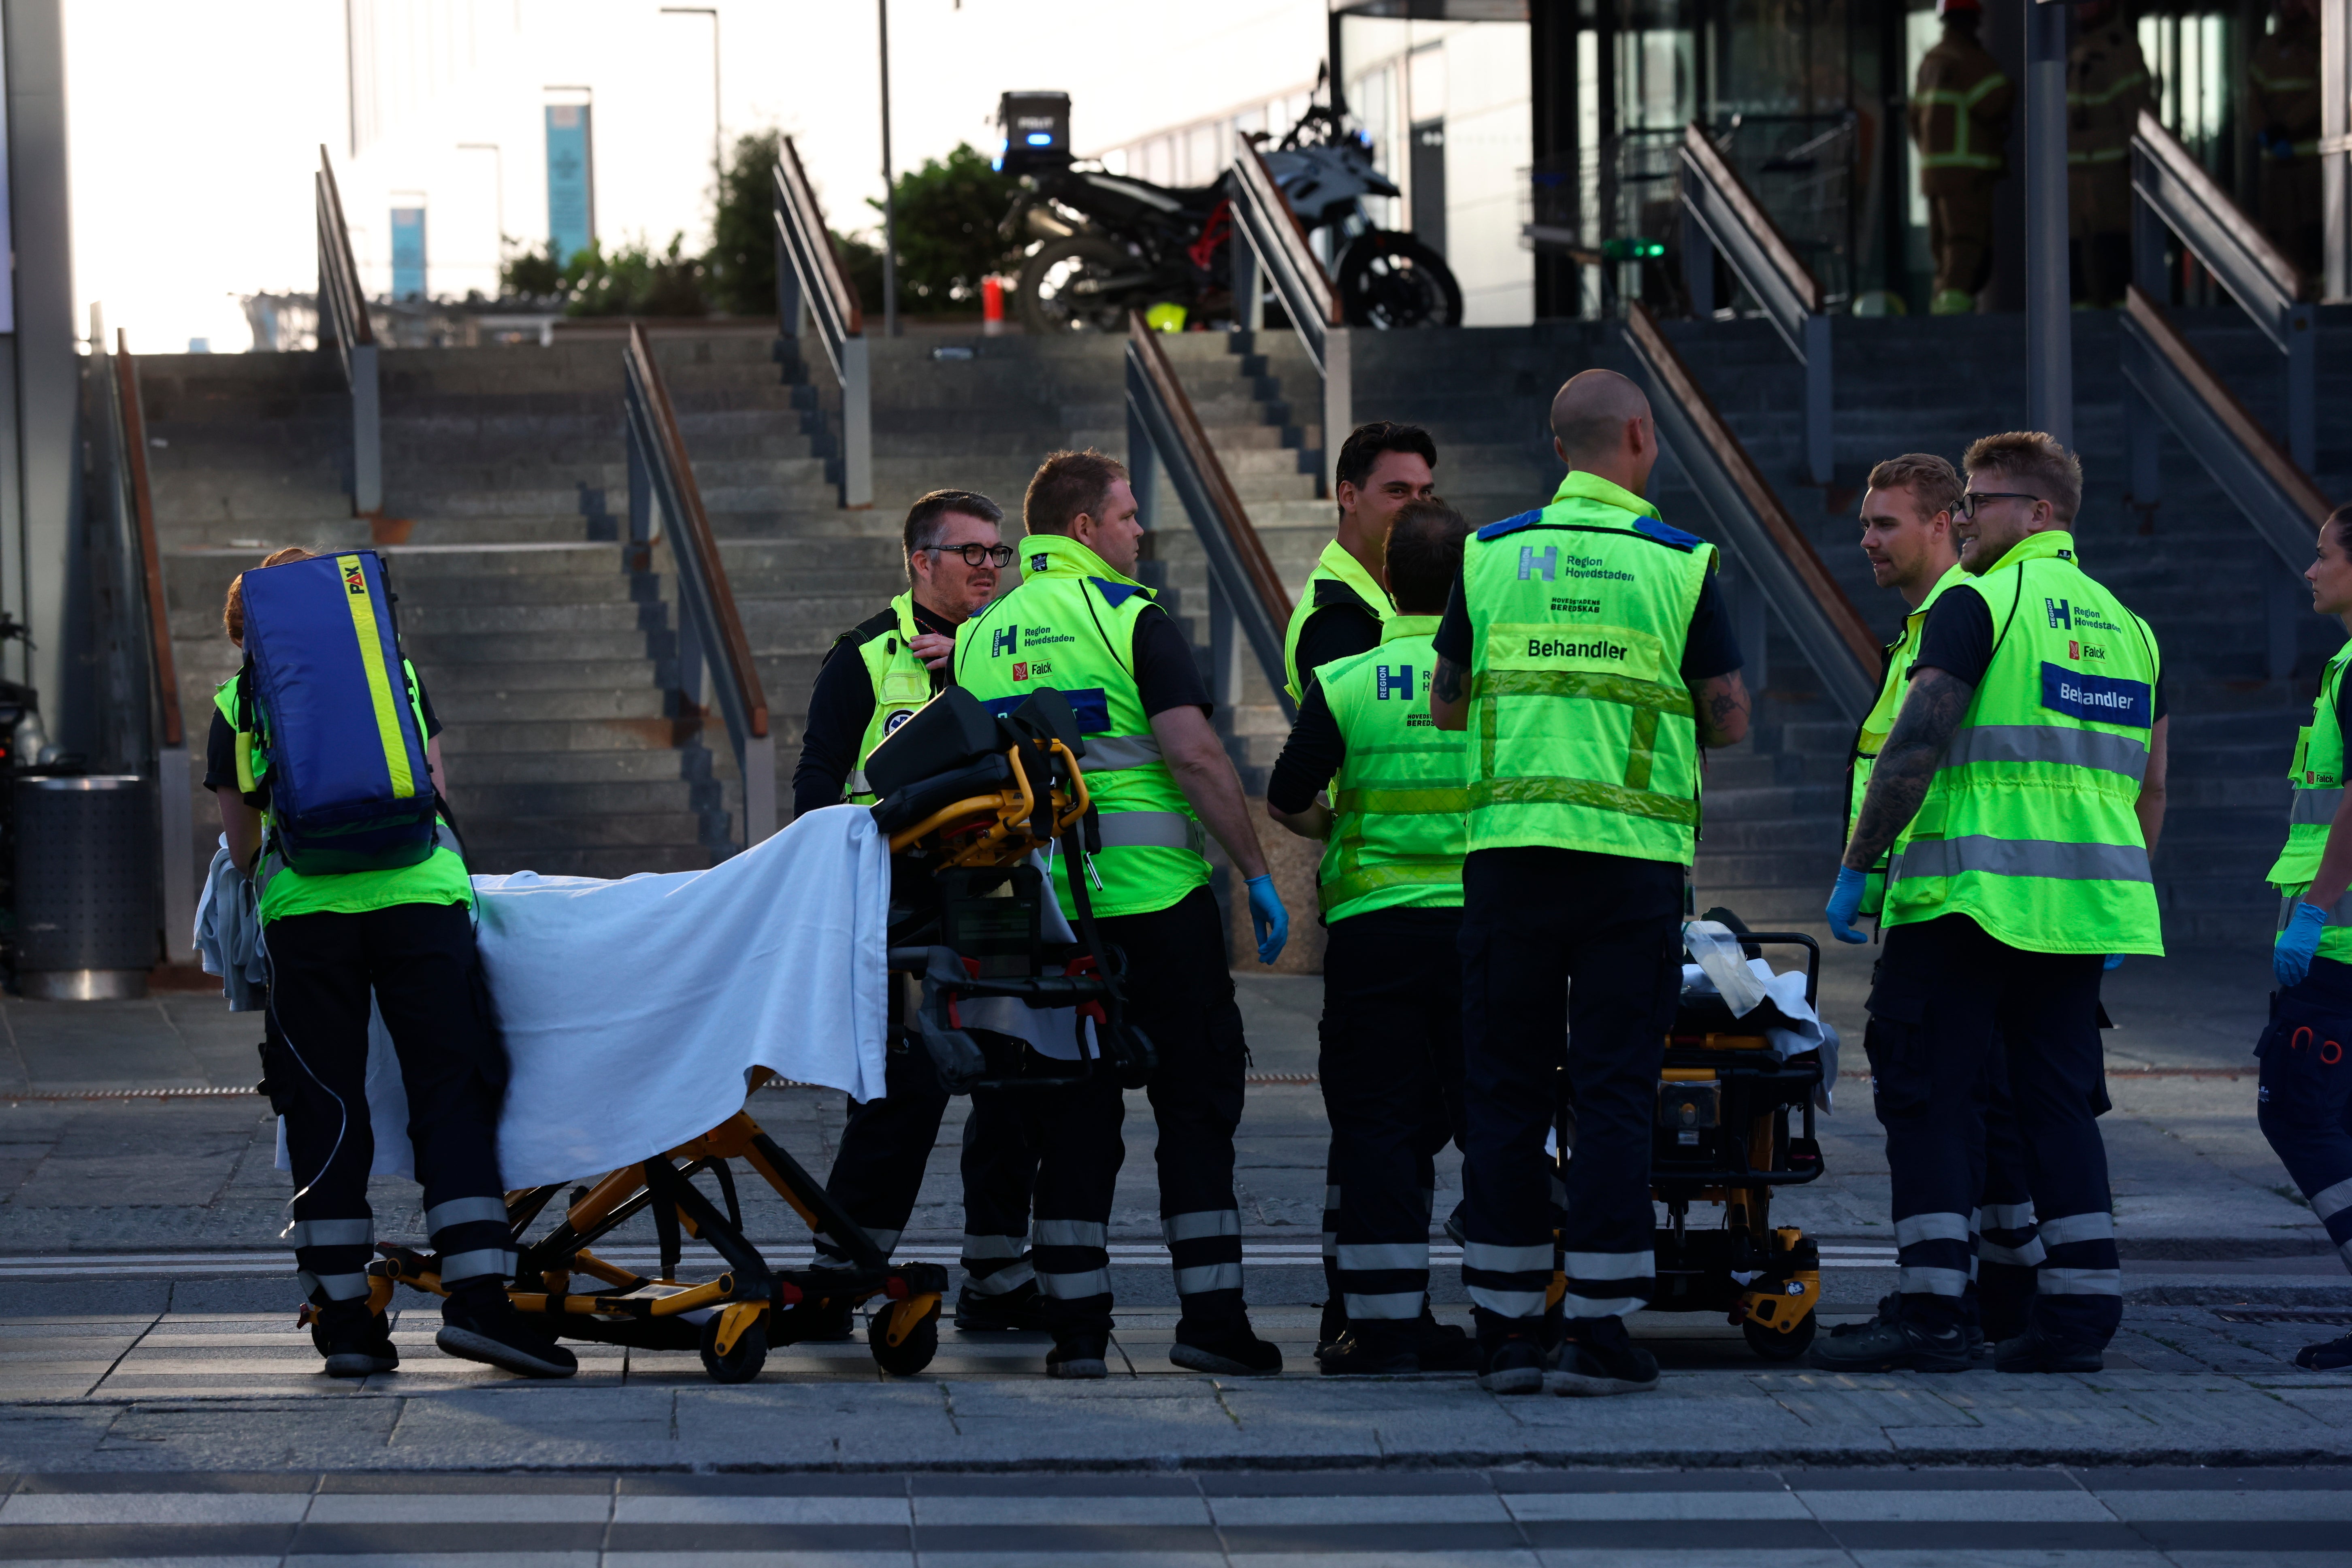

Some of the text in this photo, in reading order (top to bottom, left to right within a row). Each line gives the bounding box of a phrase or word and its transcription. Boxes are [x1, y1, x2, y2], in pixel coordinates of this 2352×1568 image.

[1521, 548, 1531, 578] REGION
[1567, 555, 1603, 568] Region
[344, 566, 365, 594] PAX
[1566, 567, 1634, 582] Hovedstaden
[1552, 597, 1600, 605] HOVEDSTADENS
[1551, 603, 1600, 613] BEREDSKAB
[2046, 599, 2056, 627] REGION
[2074, 607, 2100, 618] Region
[1025, 626, 1050, 637] Region
[2075, 617, 2122, 634] Hovedstaden
[1024, 634, 1075, 647] Hovedstaden
[1529, 639, 1628, 660] Behandler
[2084, 646, 2105, 659] Falck
[1032, 662, 1052, 675] Falck
[2061, 683, 2134, 709] Behandler
[2316, 774, 2334, 783] Falck
